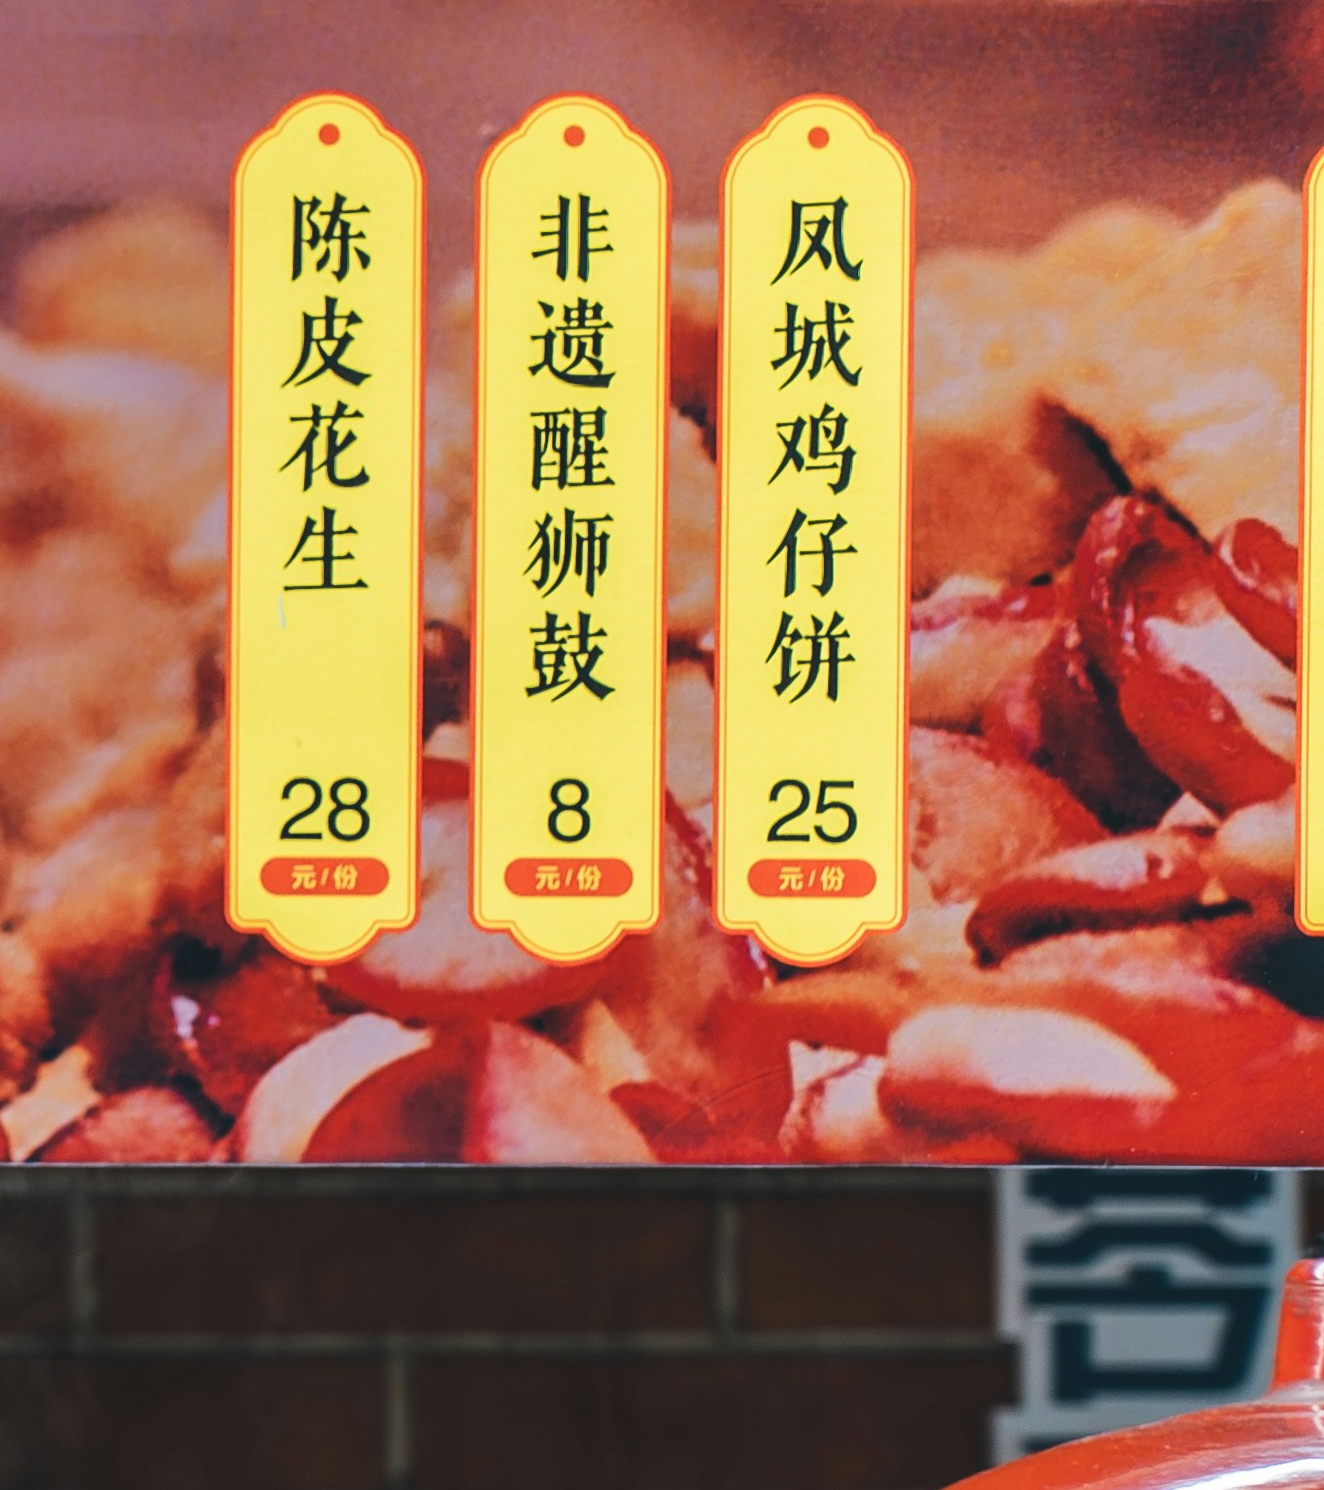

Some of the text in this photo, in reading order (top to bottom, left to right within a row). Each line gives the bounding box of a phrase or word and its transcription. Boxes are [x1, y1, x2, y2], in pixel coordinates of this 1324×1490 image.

[280, 192, 371, 591] 陈皮花生
[524, 193, 616, 702] 非遗醒狮鼓
[765, 196, 863, 704] 凤城鸡仔饼
[279, 777, 370, 842] 28
[547, 778, 591, 844] 8
[766, 778, 858, 844] 25
